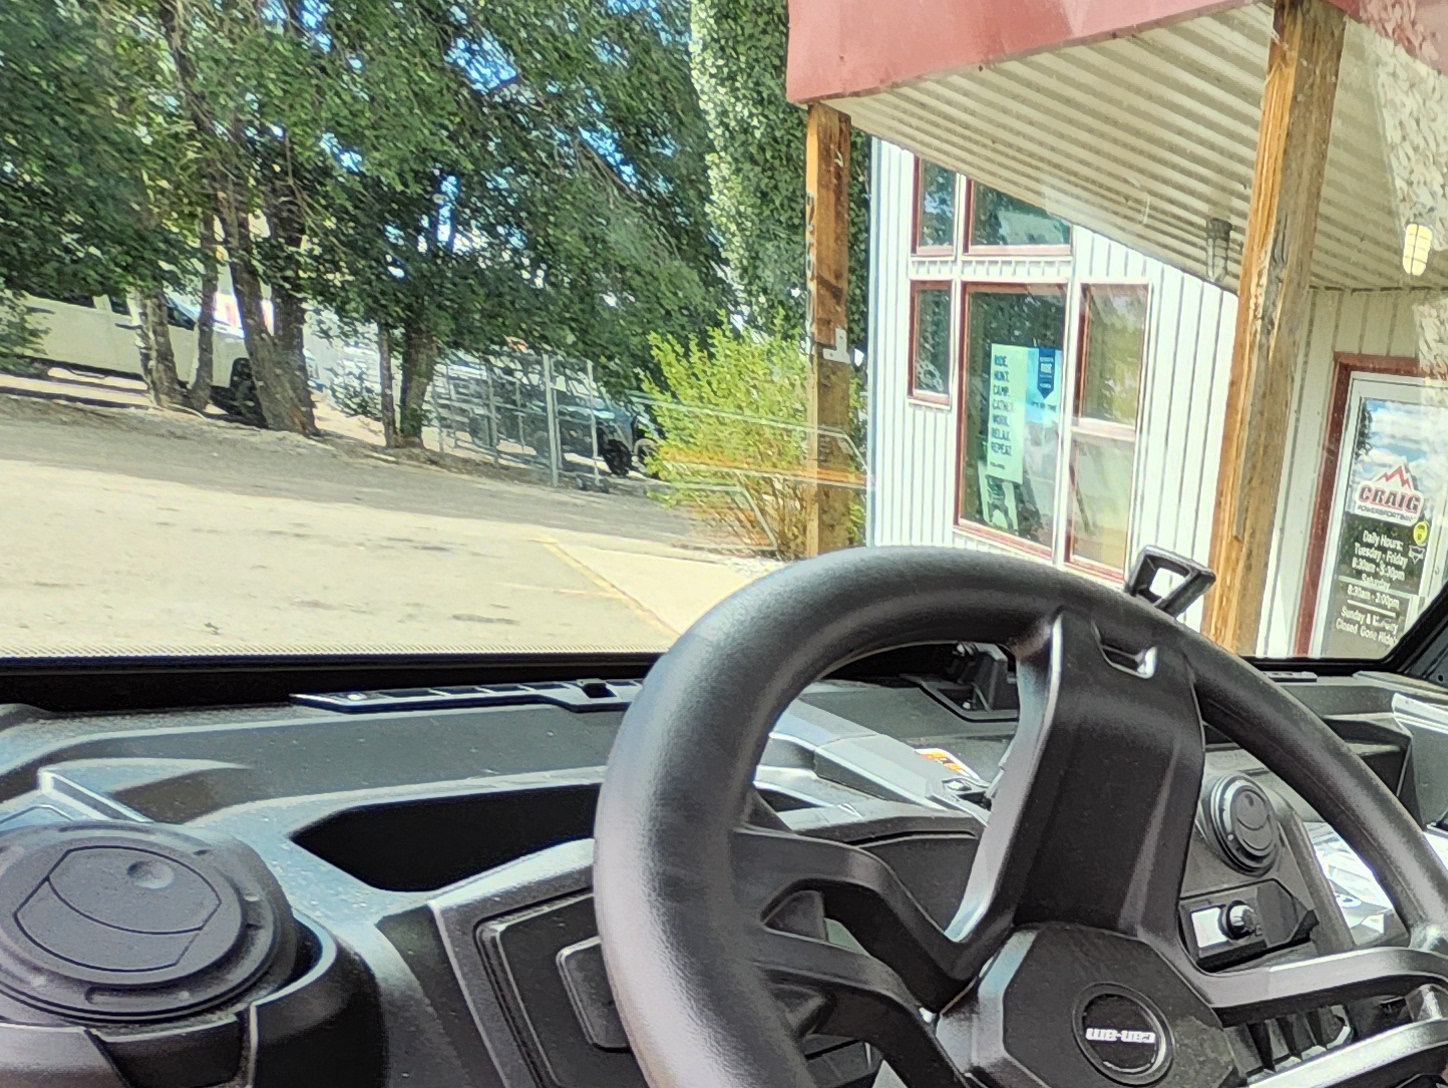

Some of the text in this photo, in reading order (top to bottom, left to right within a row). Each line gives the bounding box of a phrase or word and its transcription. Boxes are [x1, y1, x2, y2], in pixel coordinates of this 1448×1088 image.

[1358, 483, 1421, 515] CRAIG
[1355, 542, 1382, 563] Tuesday
[1386, 550, 1408, 570] Friday
[1085, 1027, 1156, 1044] can-am
